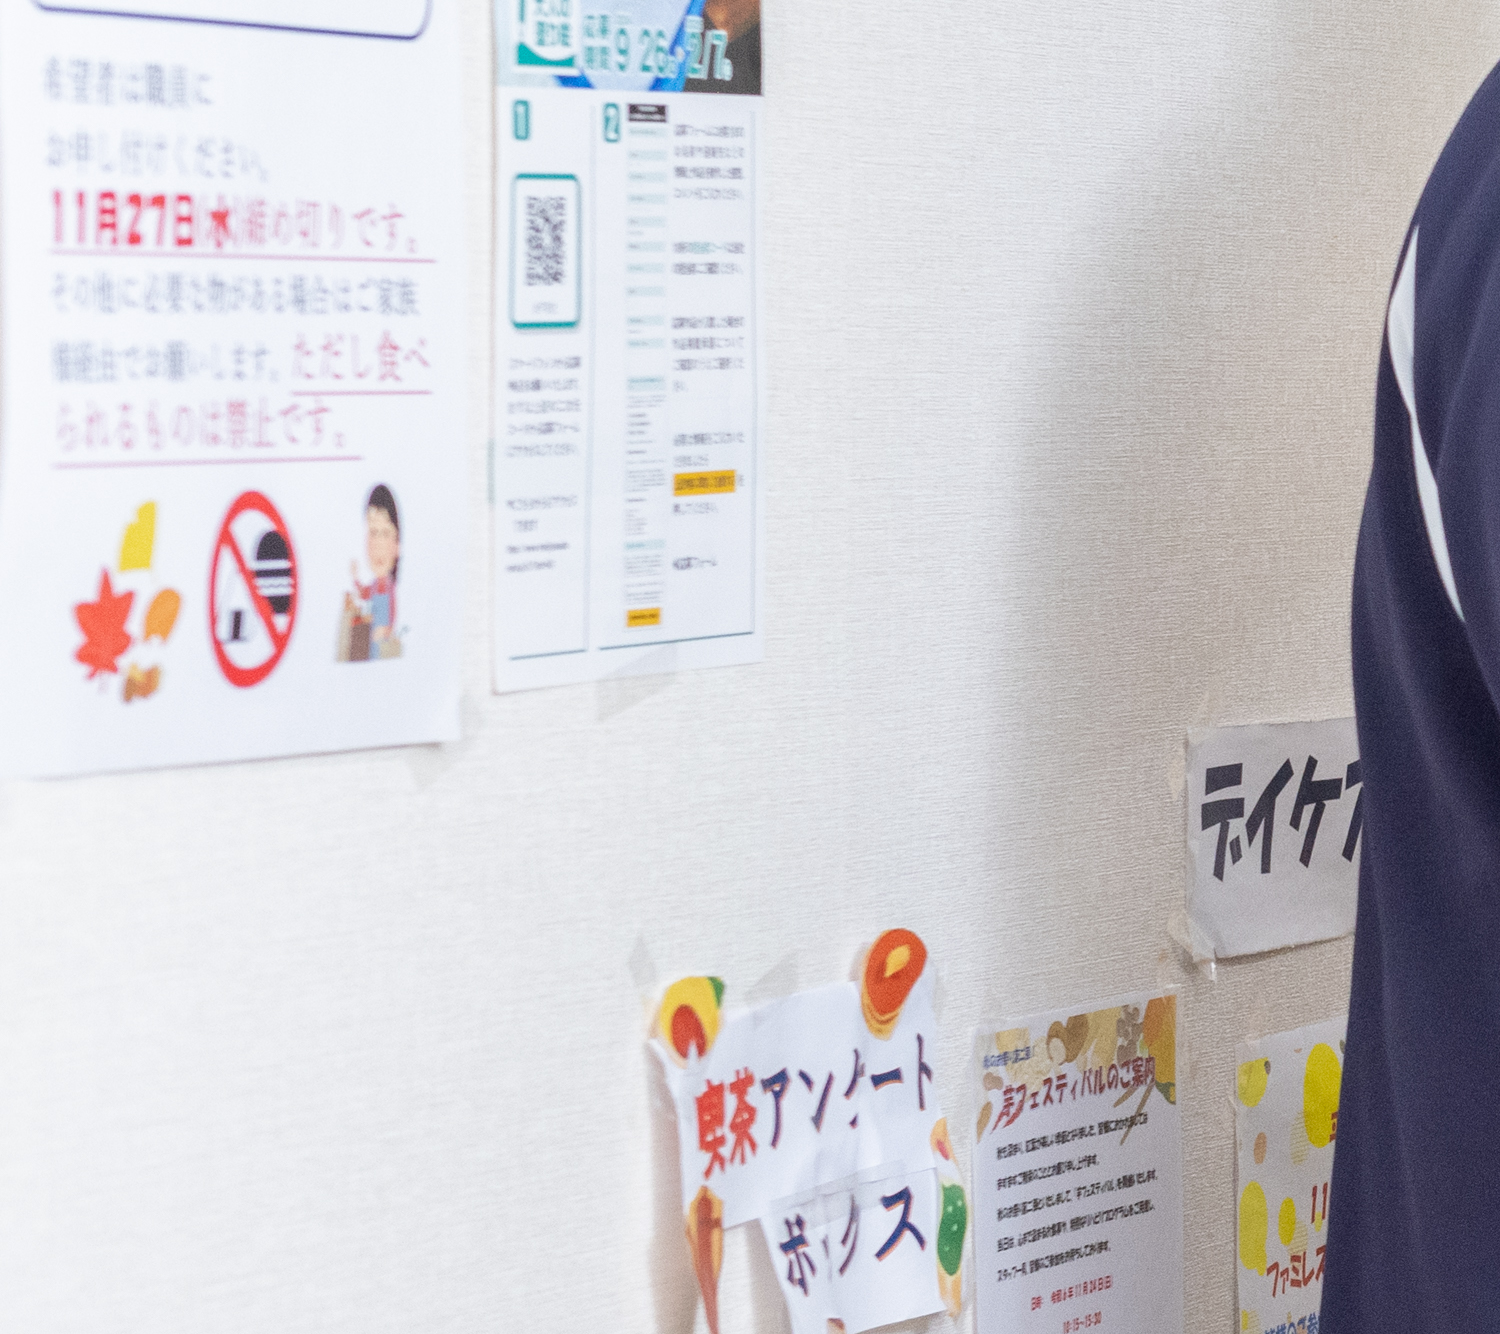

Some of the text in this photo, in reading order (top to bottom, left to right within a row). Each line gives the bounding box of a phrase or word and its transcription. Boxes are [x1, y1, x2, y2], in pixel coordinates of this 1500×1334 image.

[990, 1055, 1156, 1134] 芋フェスティバルのご案内
